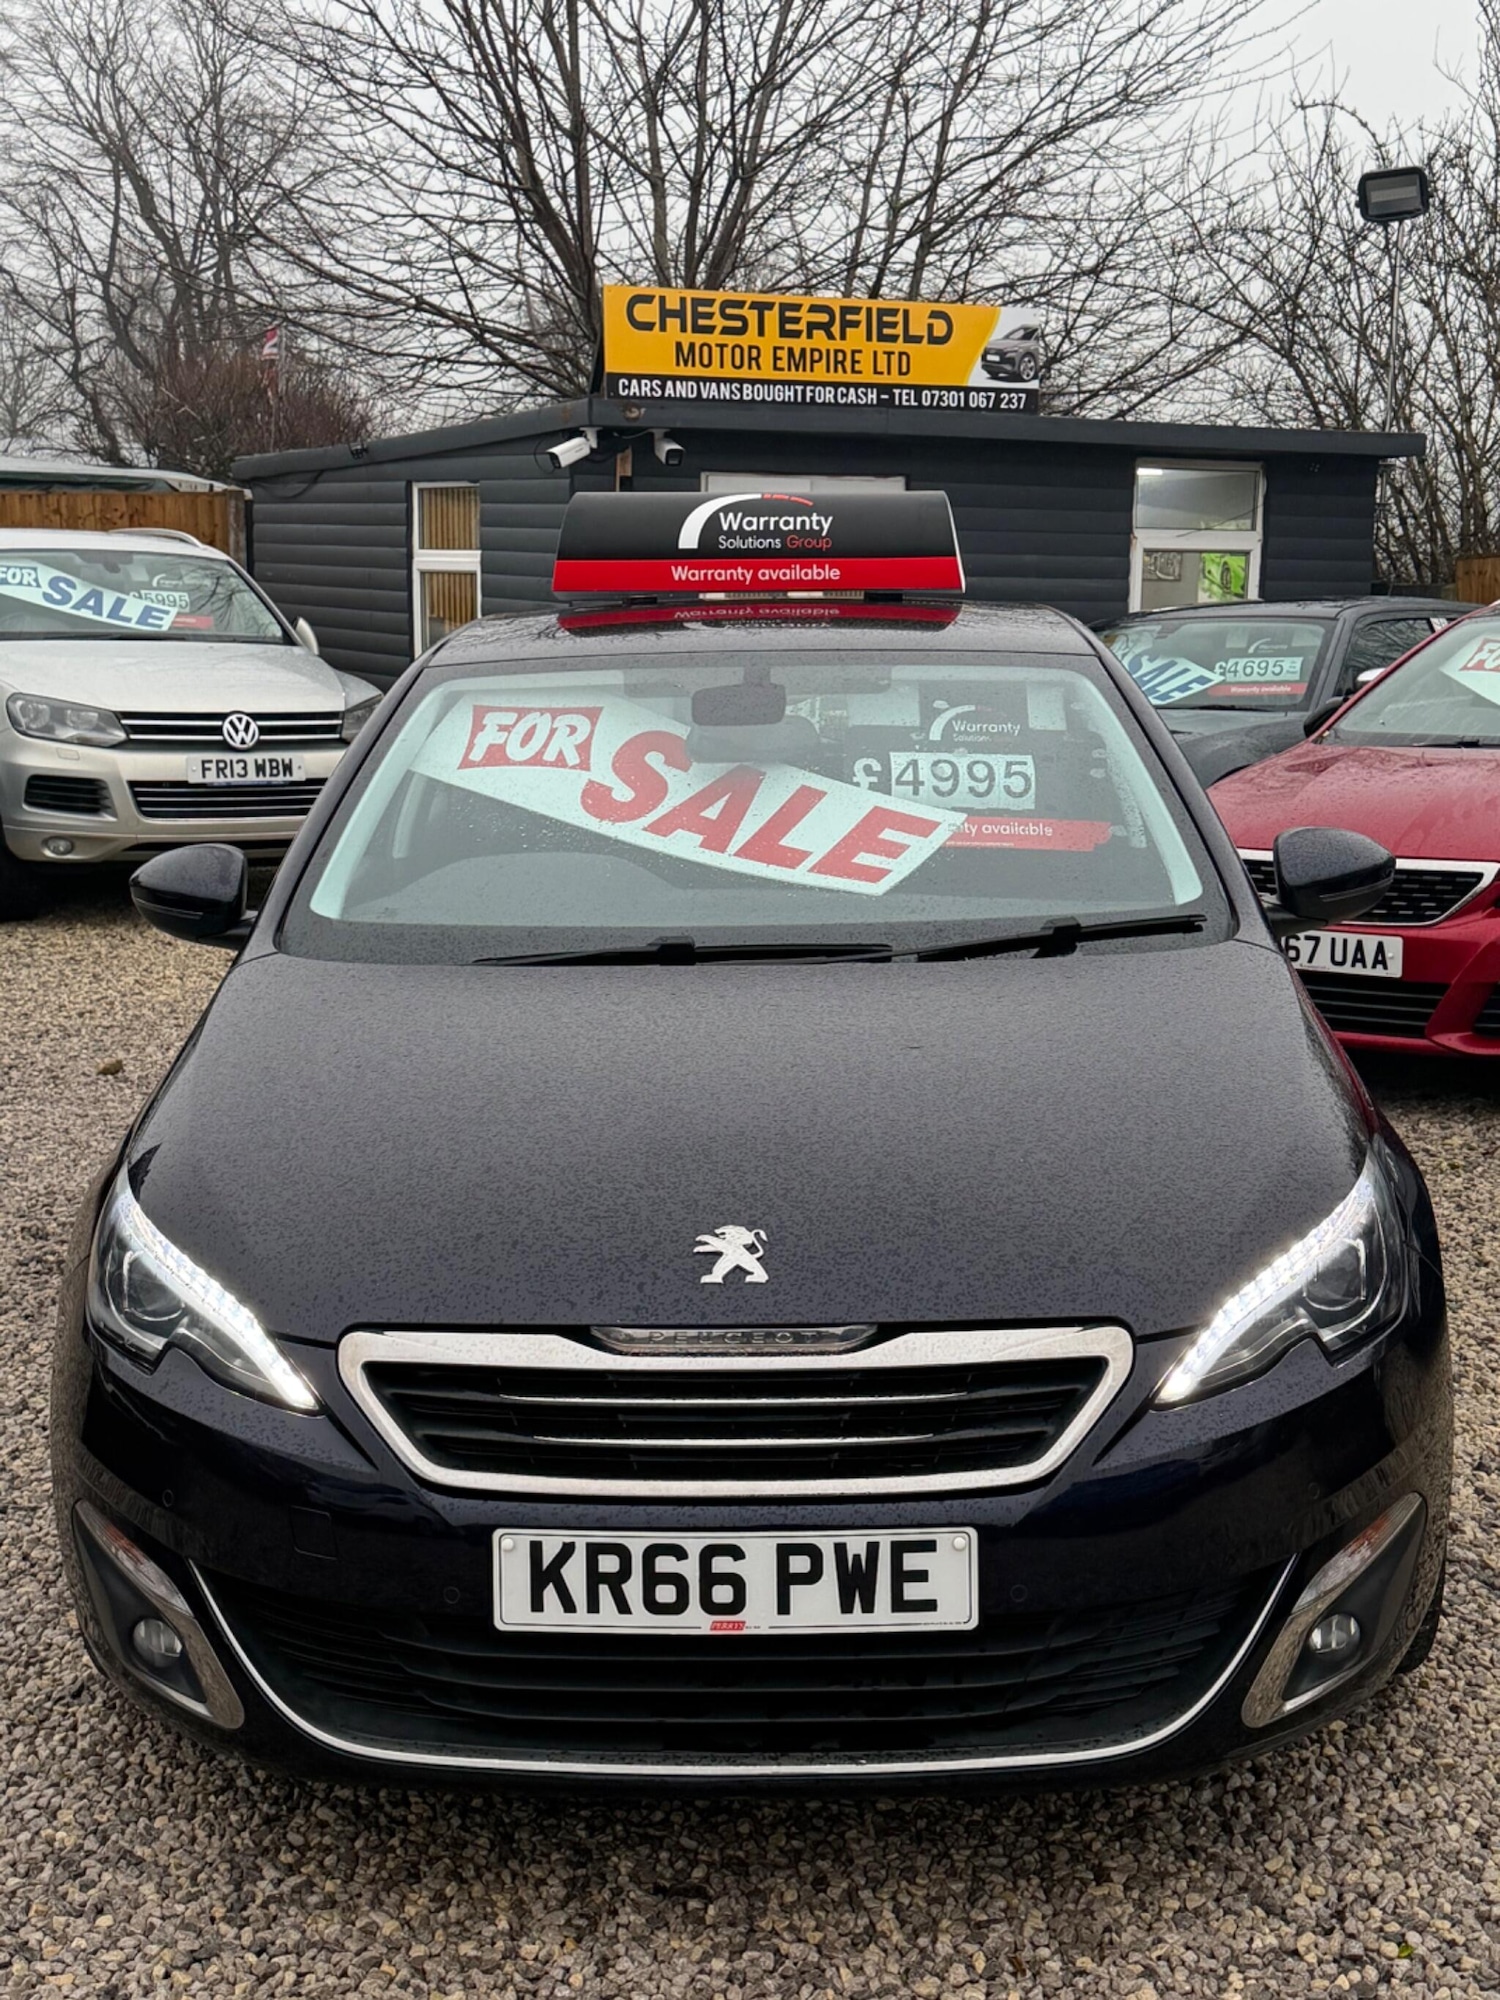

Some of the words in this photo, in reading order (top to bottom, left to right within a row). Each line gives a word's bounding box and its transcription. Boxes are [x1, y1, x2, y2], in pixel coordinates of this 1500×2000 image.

[626, 294, 954, 346] CHESTERFIELD
[675, 341, 761, 371] MOTOR
[772, 346, 863, 374] EMPIRE
[873, 350, 911, 376] LTD
[618, 378, 661, 397] CARS
[665, 381, 697, 399] AND
[699, 381, 743, 400] VANS
[743, 384, 807, 403] BOUGHT
[809, 386, 835, 404] FOR
[837, 386, 877, 405] CASH
[892, 389, 918, 406] TEL
[922, 390, 965, 407] 07301
[969, 391, 995, 408] 067
[1000, 392, 1026, 409] 237
[719, 512, 833, 537] Warranty
[718, 535, 782, 549] Solutions
[786, 534, 833, 551] Group
[670, 565, 753, 585] Warranty
[757, 564, 841, 580] available
[42, 576, 171, 629] SALE
[1128, 647, 1215, 702] SALE
[1214, 660, 1285, 678] £4695
[468, 711, 593, 767] FOR
[952, 720, 1020, 736] Warranty
[201, 759, 248, 778] FR13
[254, 758, 293, 777] WBW
[852, 757, 1033, 799] £4995
[580, 730, 942, 883] SALE
[981, 822, 1053, 837] available
[1330, 937, 1388, 970] UAA
[649, 1331, 819, 1344] PEUGEOT
[529, 1540, 747, 1616] KR66
[776, 1540, 938, 1616] PWE
